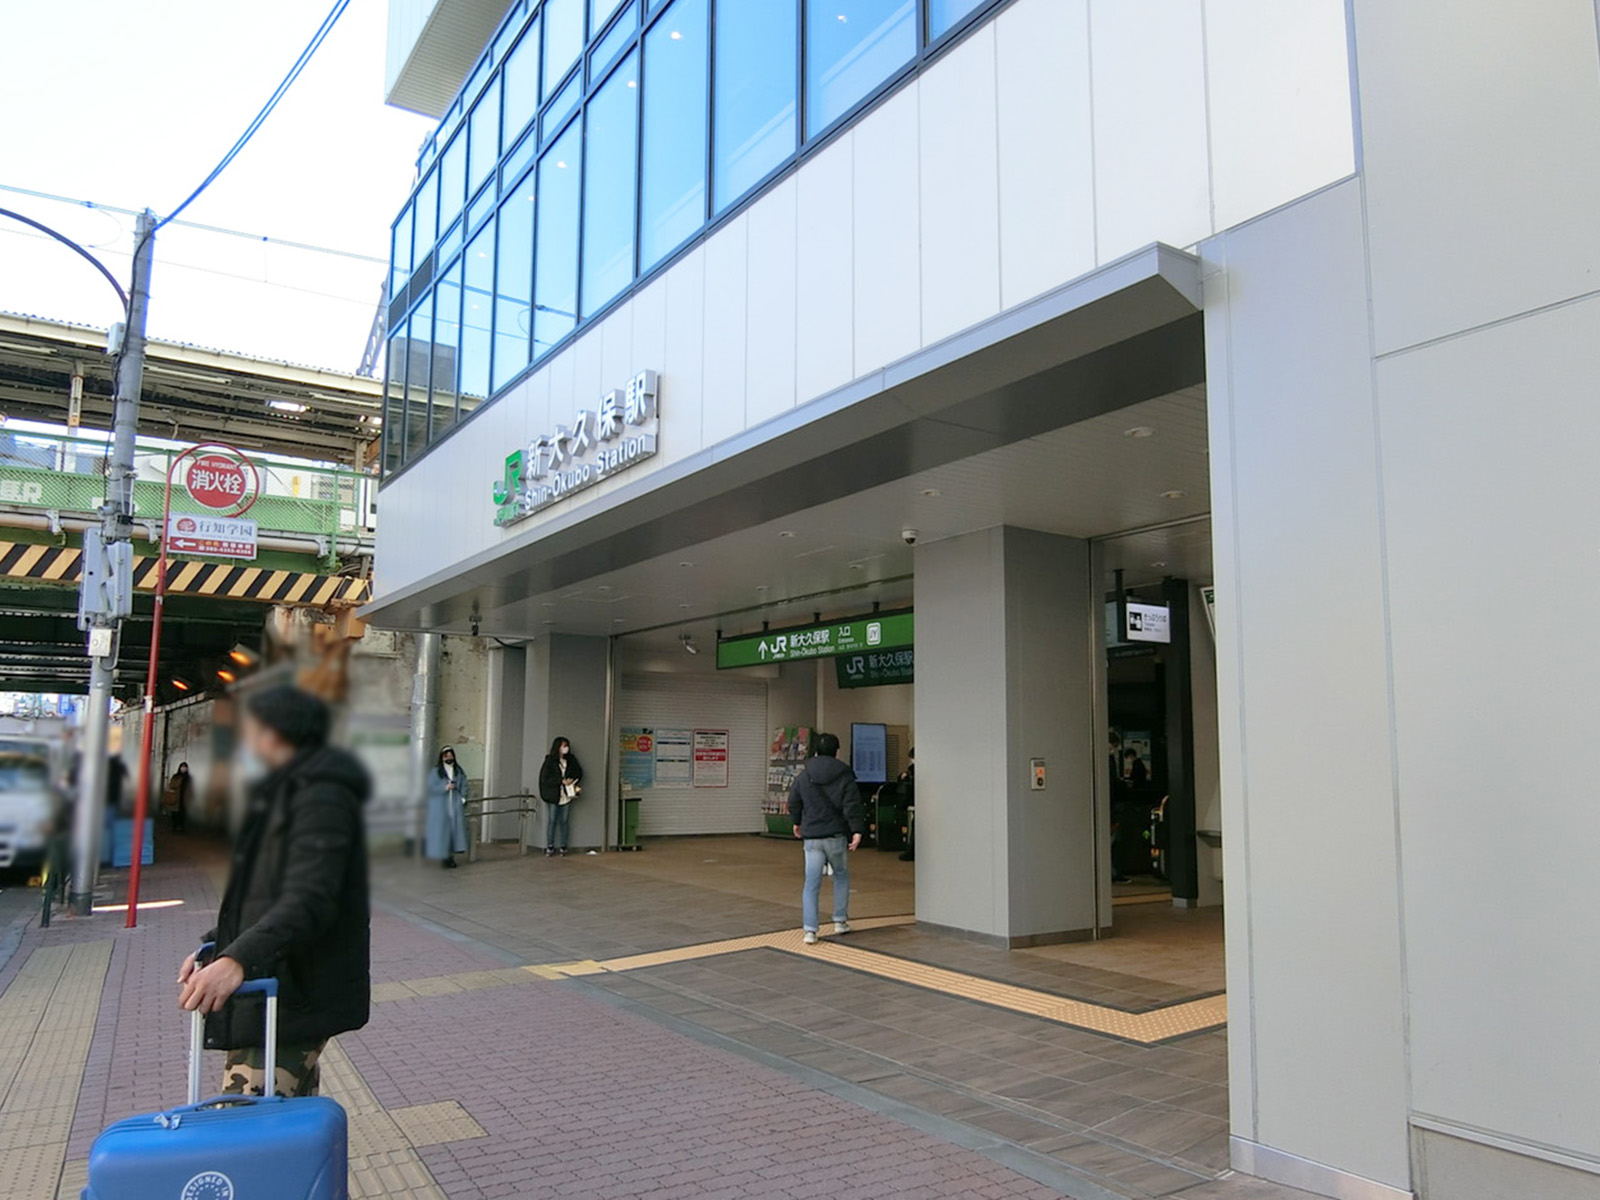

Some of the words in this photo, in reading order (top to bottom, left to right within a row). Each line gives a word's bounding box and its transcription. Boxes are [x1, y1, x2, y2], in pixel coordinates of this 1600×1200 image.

[527, 369, 655, 481] 新大久保駅
[191, 469, 242, 494] 消火栓
[494, 449, 523, 505] JR
[525, 464, 591, 510] Shin-Okubo
[596, 434, 648, 475] Station
[790, 629, 830, 648] 新大久保駅
[838, 626, 851, 637] 入口
[770, 636, 787, 653] JR
[846, 656, 865, 674] JR
